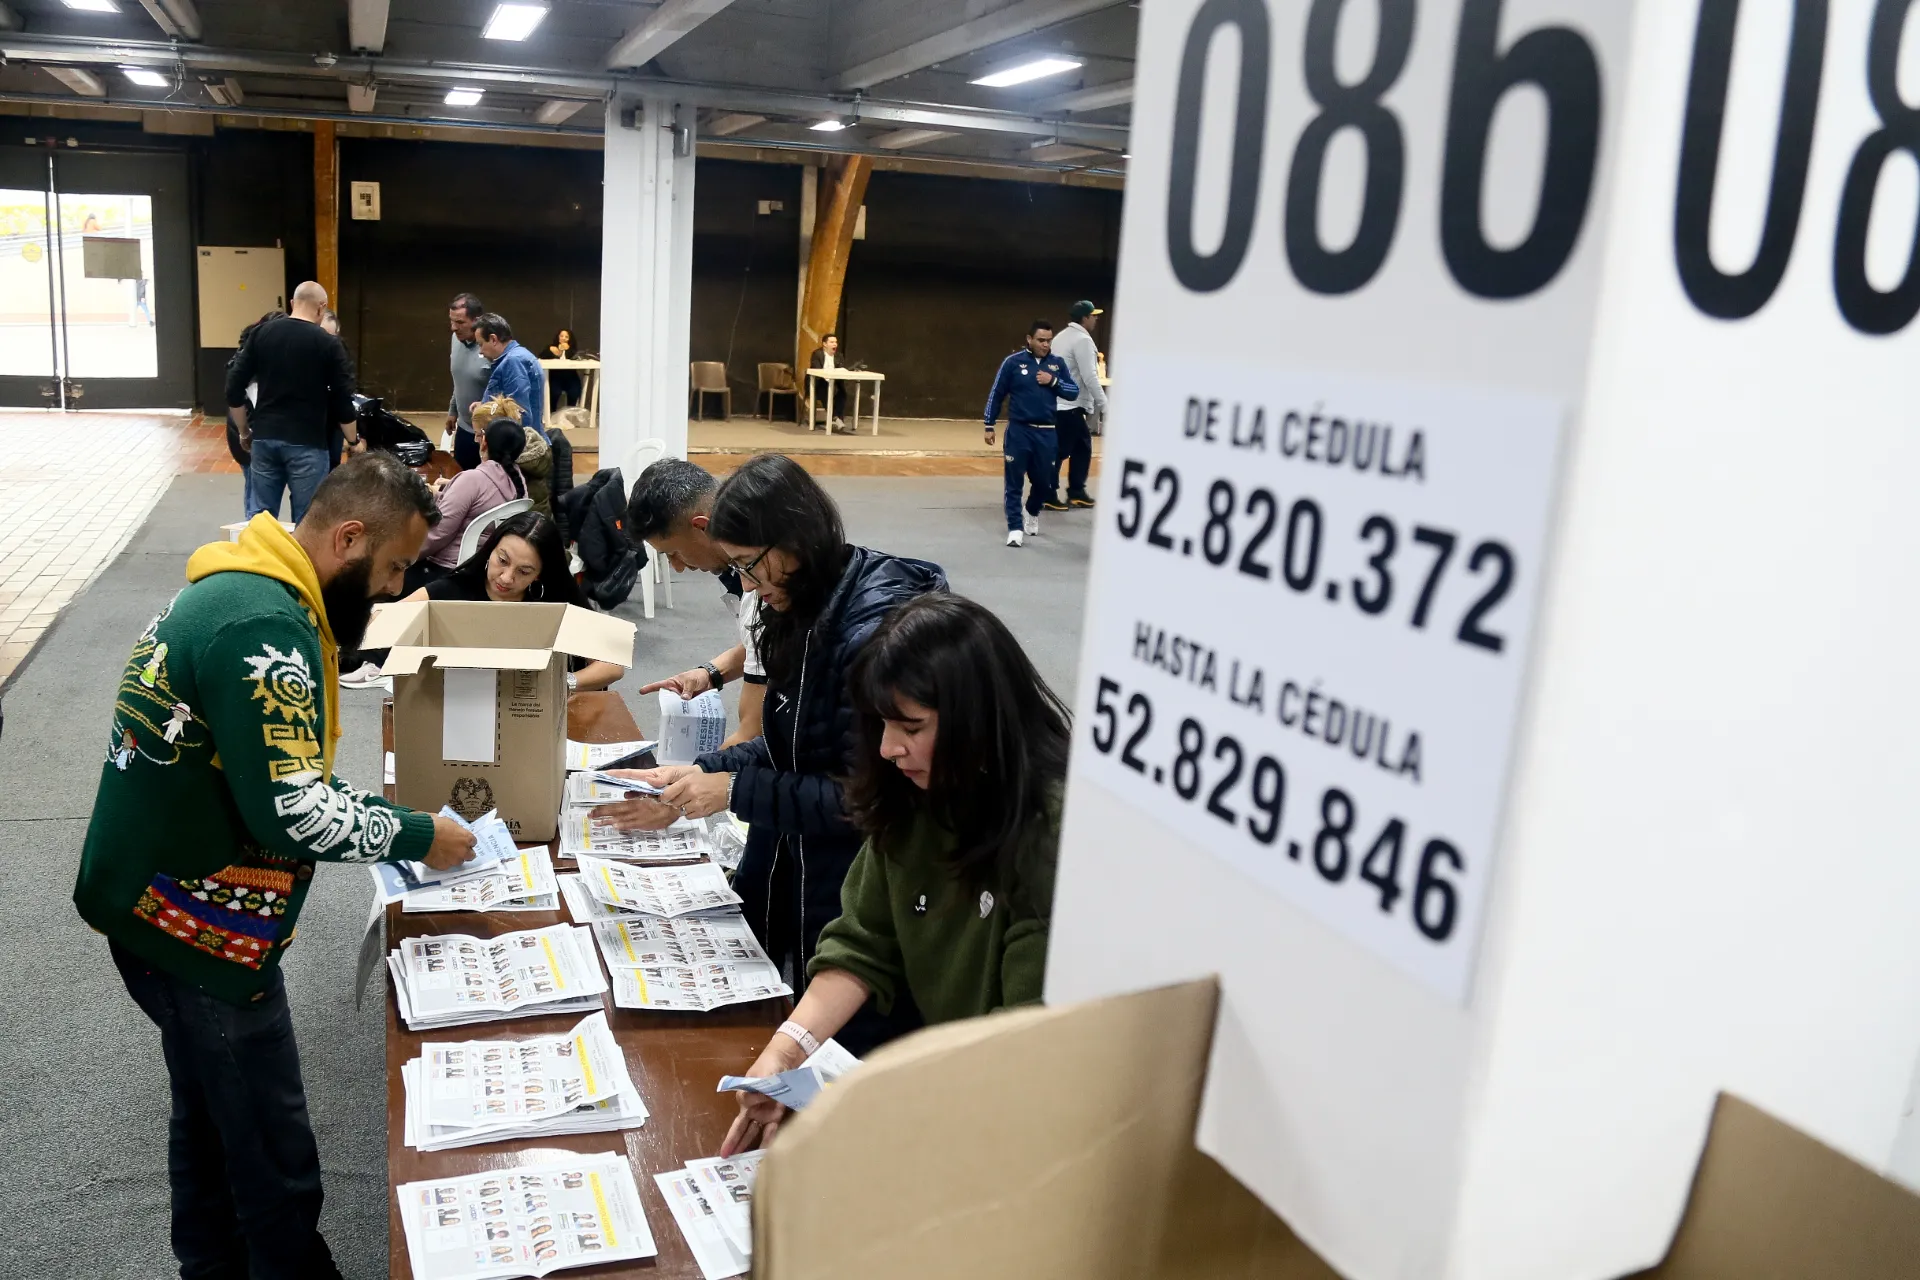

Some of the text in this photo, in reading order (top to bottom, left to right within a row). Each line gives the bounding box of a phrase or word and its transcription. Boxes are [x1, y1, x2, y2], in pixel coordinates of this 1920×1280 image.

[1166, 0, 1606, 302] 086
[1183, 396, 1426, 482] DE LA CÉDULA
[1115, 457, 1518, 656] 52.820.372
[699, 698, 709, 752] PRESIDENCIA
[1133, 621, 1422, 783] HASTA LA CÉDULA
[1091, 674, 1467, 945] 52.829.846
